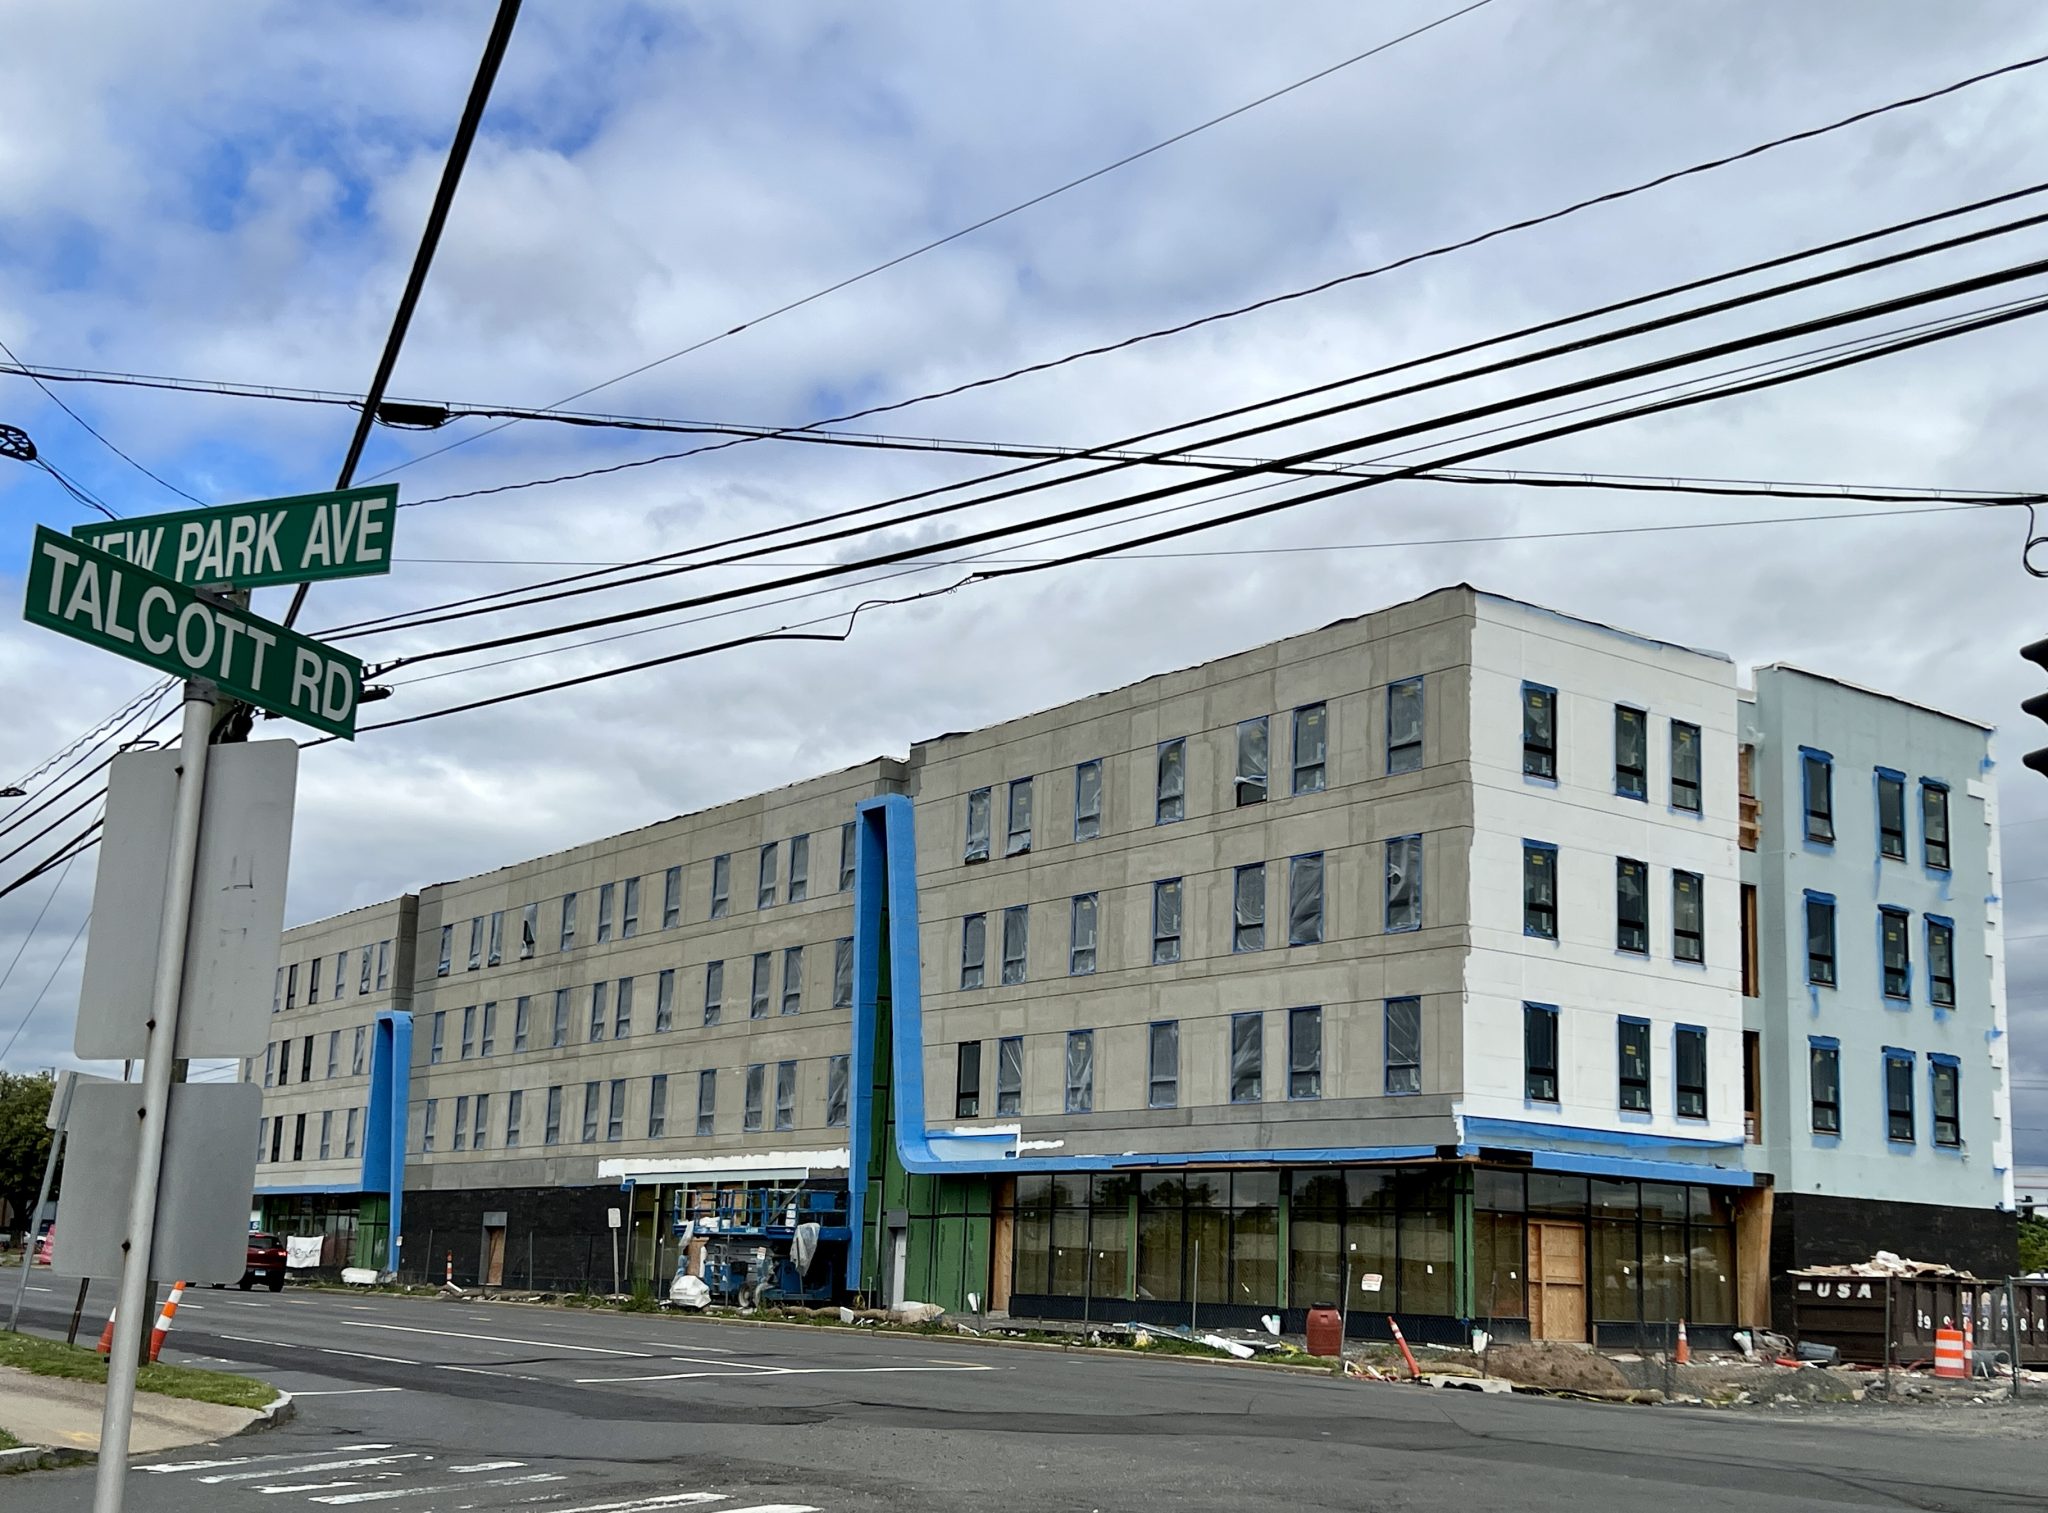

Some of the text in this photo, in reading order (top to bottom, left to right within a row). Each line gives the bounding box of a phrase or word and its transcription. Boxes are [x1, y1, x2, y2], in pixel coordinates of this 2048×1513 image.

[77, 497, 388, 582] EW PARK AVE
[42, 542, 355, 723] TALCOTT RD
[1816, 1282, 1872, 1299] USA
